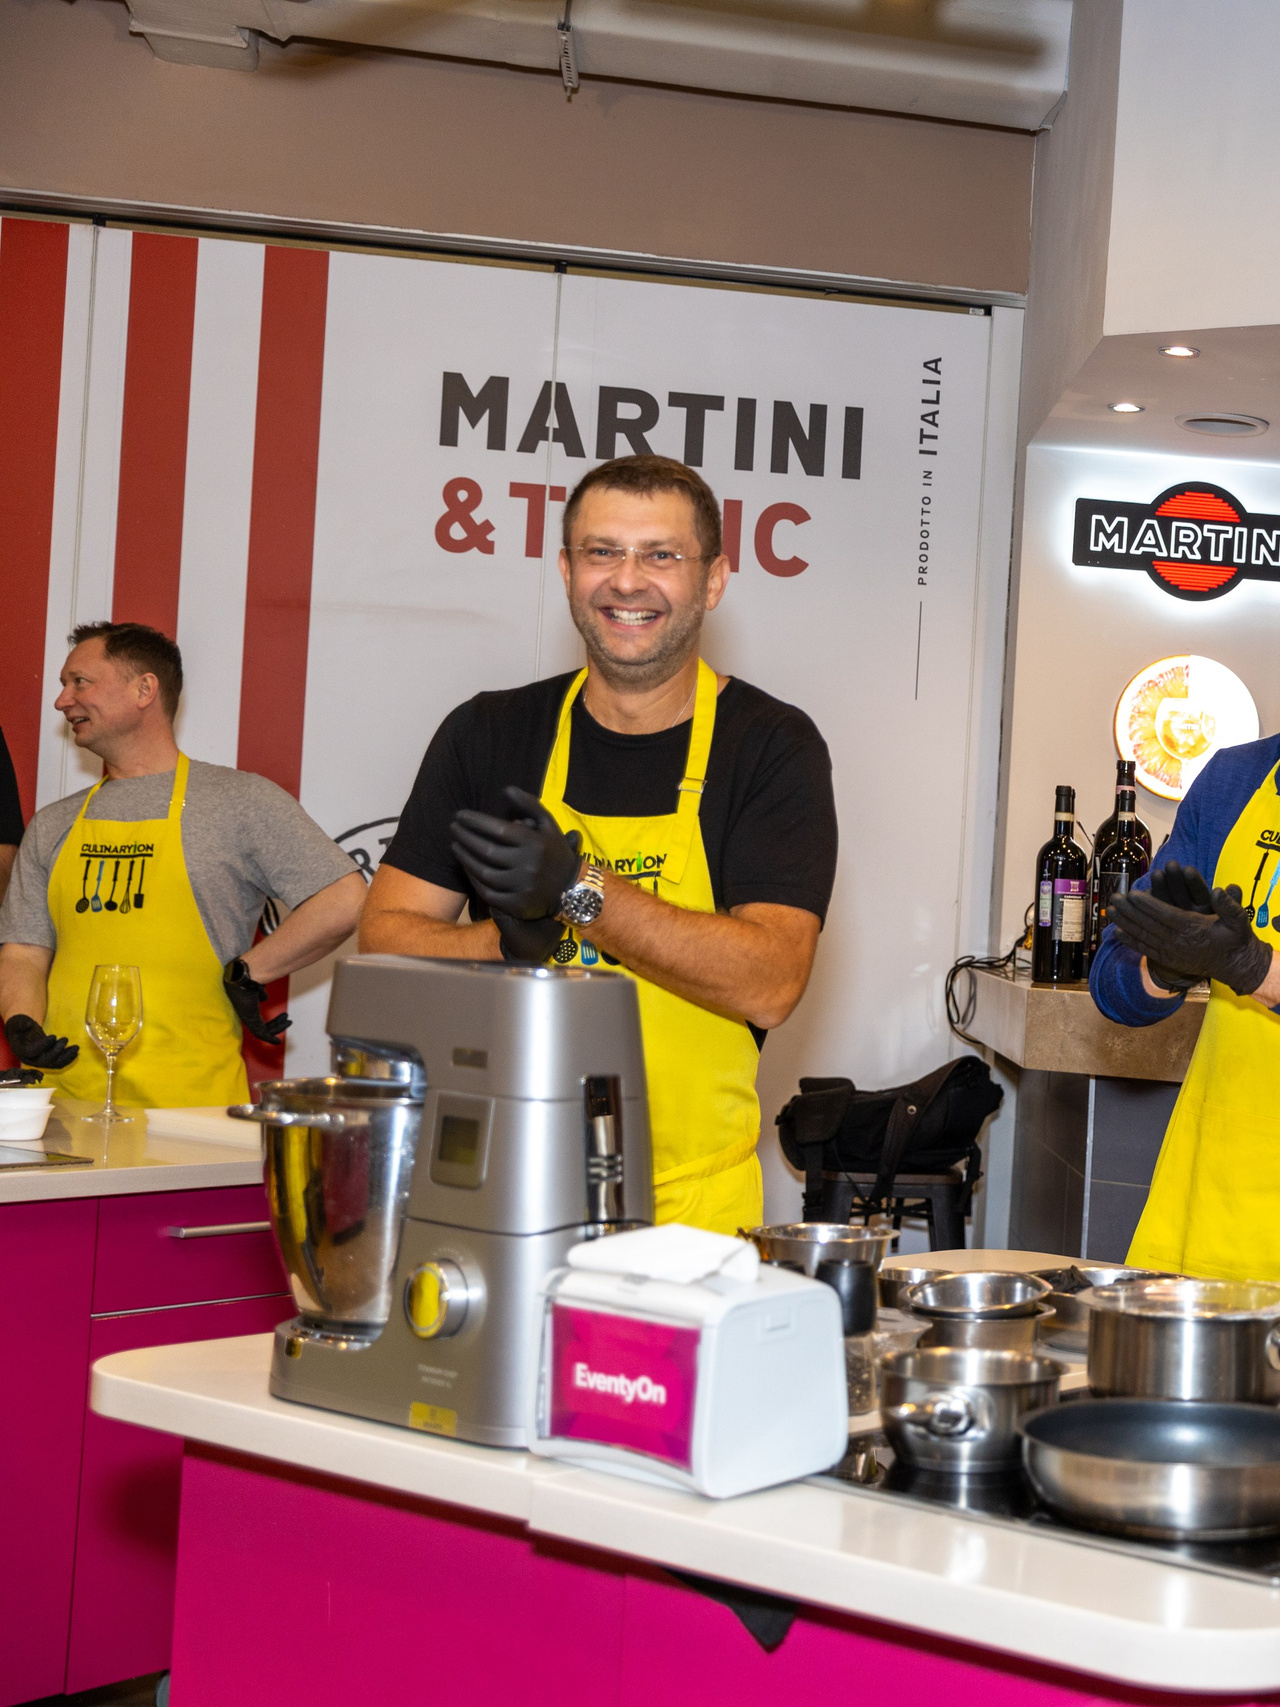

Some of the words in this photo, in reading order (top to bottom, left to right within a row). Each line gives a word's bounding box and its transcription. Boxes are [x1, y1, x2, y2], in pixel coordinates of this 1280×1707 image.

[439, 371, 865, 480] MARTINI
[919, 357, 942, 456] ITALIA
[922, 470, 933, 486] IN
[434, 477, 496, 555] &
[509, 481, 812, 578] TIC
[917, 496, 932, 586] PRODOTTO
[574, 1362, 668, 1405] EventyOn
